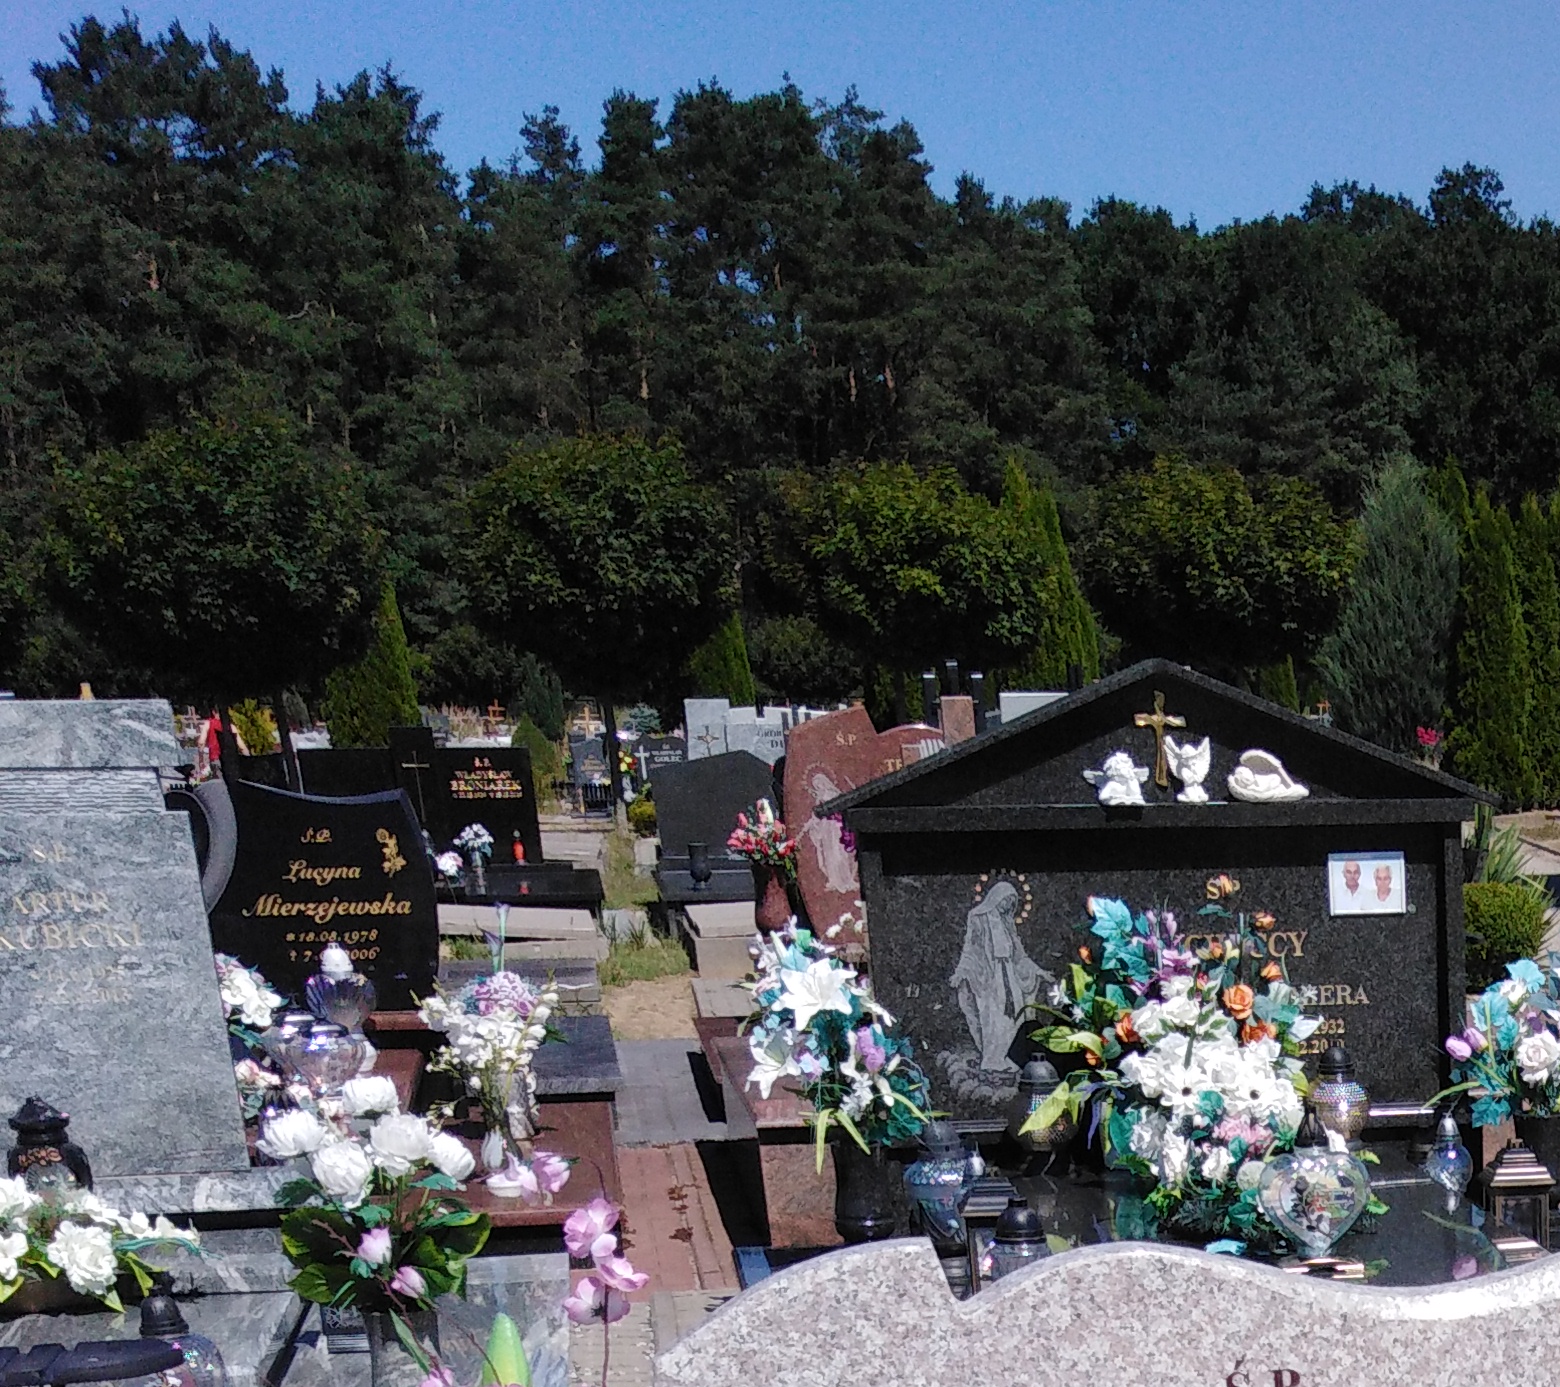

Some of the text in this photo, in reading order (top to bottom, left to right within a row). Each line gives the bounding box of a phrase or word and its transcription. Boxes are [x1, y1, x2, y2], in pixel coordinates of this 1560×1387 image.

[653, 755, 683, 763] GOLEC
[449, 780, 523, 791] BRONIAREK
[282, 859, 362, 886] Lucyna
[241, 892, 412, 924] Mierzejewska
